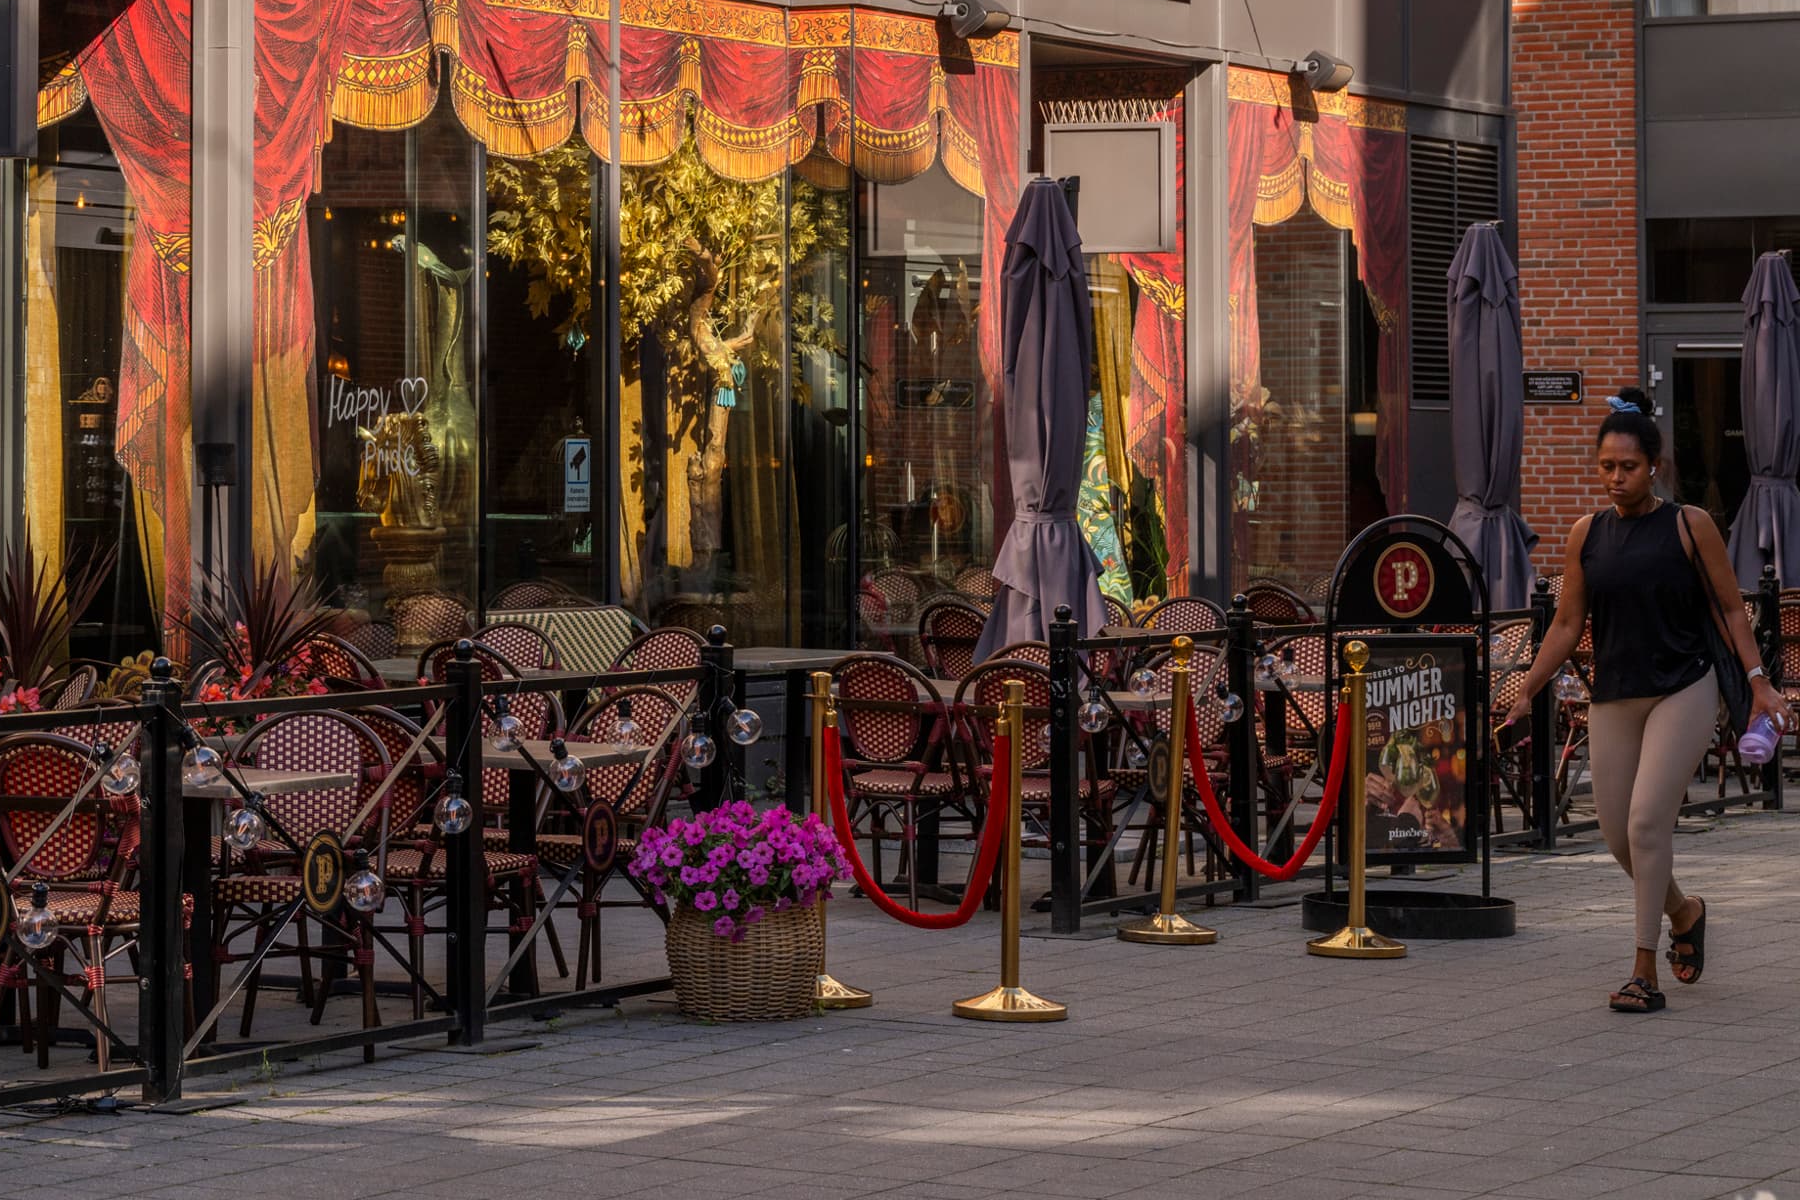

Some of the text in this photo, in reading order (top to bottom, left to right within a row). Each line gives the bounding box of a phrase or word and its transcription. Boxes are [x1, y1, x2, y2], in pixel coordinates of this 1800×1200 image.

[327, 375, 391, 437] Happy
[363, 432, 421, 480] Pride
[1365, 667, 1443, 709] SUMMER
[1394, 665, 1405, 674] TO
[1388, 693, 1456, 733] NIGHTS
